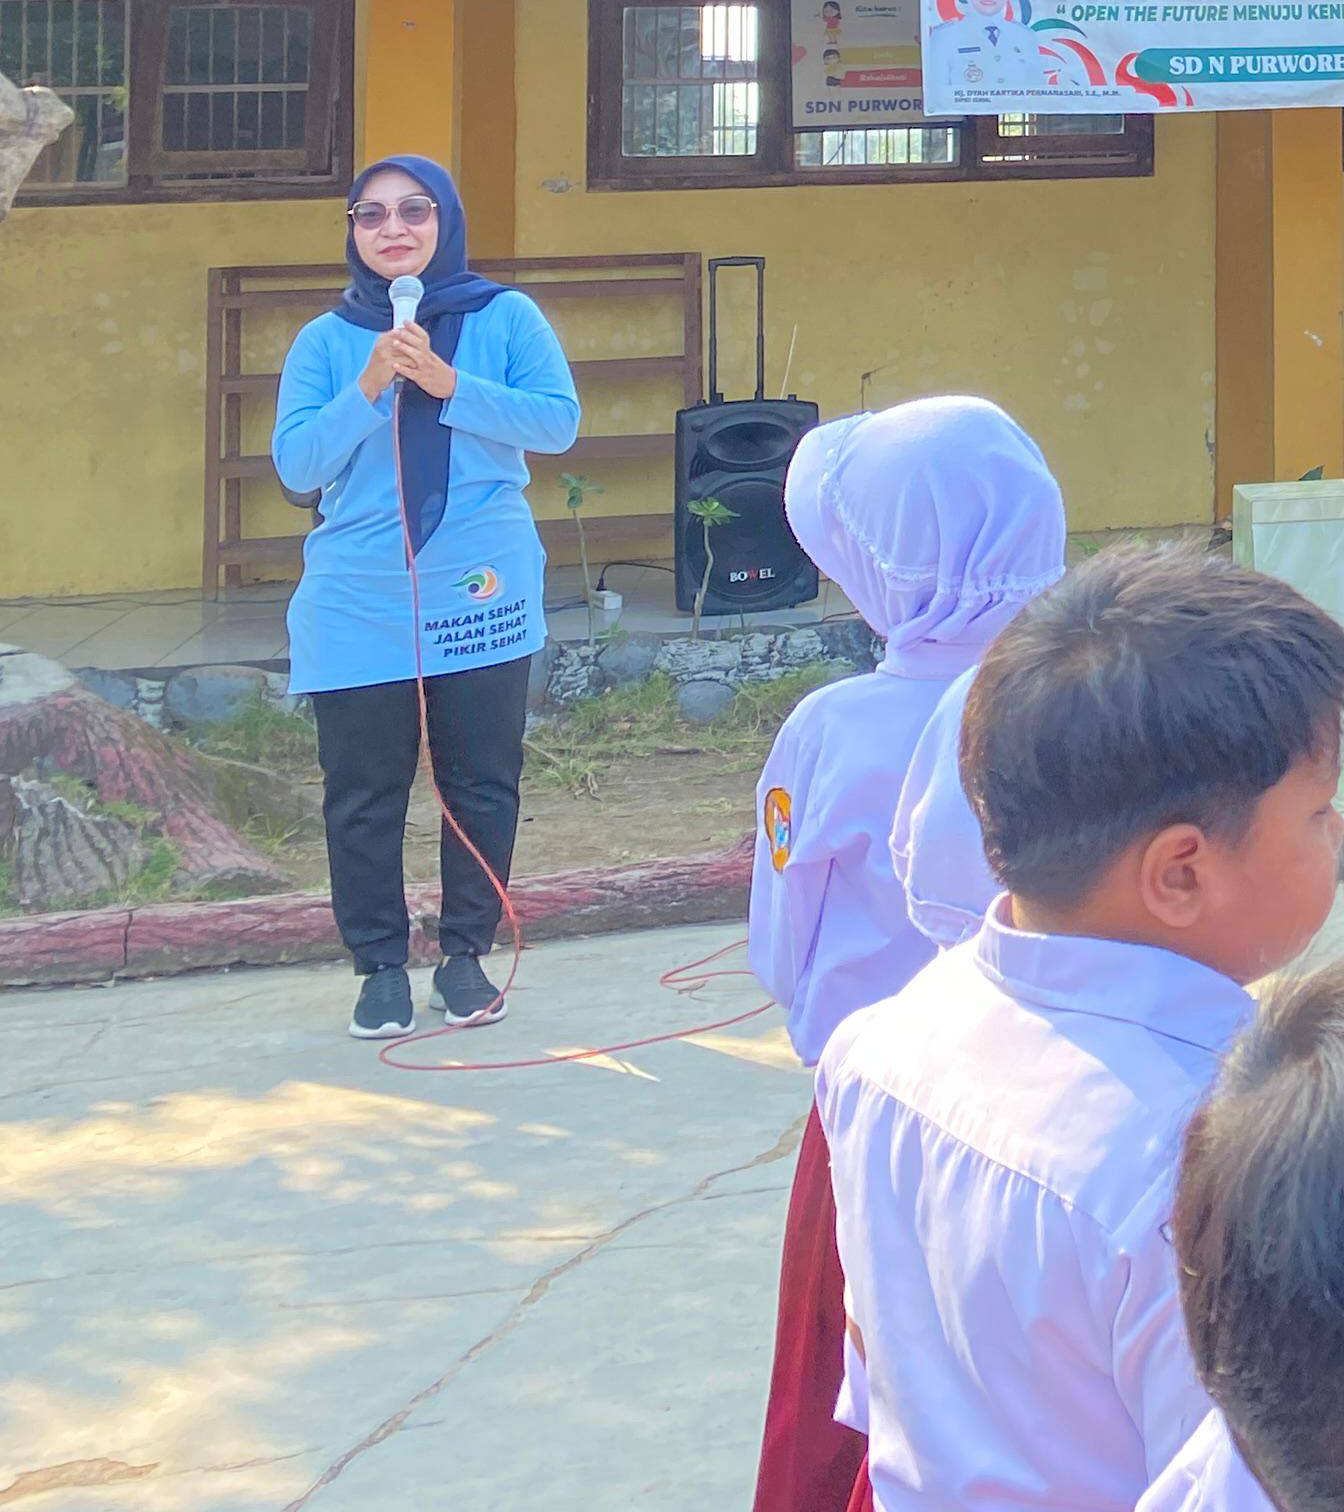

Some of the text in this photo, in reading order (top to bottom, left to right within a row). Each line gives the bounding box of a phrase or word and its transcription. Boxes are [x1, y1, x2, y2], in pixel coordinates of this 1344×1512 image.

[1071, 5, 1119, 22] OPEN
[1124, 5, 1157, 21] THE
[1162, 4, 1228, 21] FUTURE
[1233, 4, 1302, 21] MENUJU
[1169, 56, 1203, 75] SD
[1209, 56, 1225, 75] N
[805, 100, 841, 114] SDN
[729, 568, 776, 583] BOWEL
[424, 599, 526, 632] MAKAN SEHAT
[433, 614, 527, 645] JALAN SEHAT
[443, 629, 527, 658] PIKIR SEHAT
